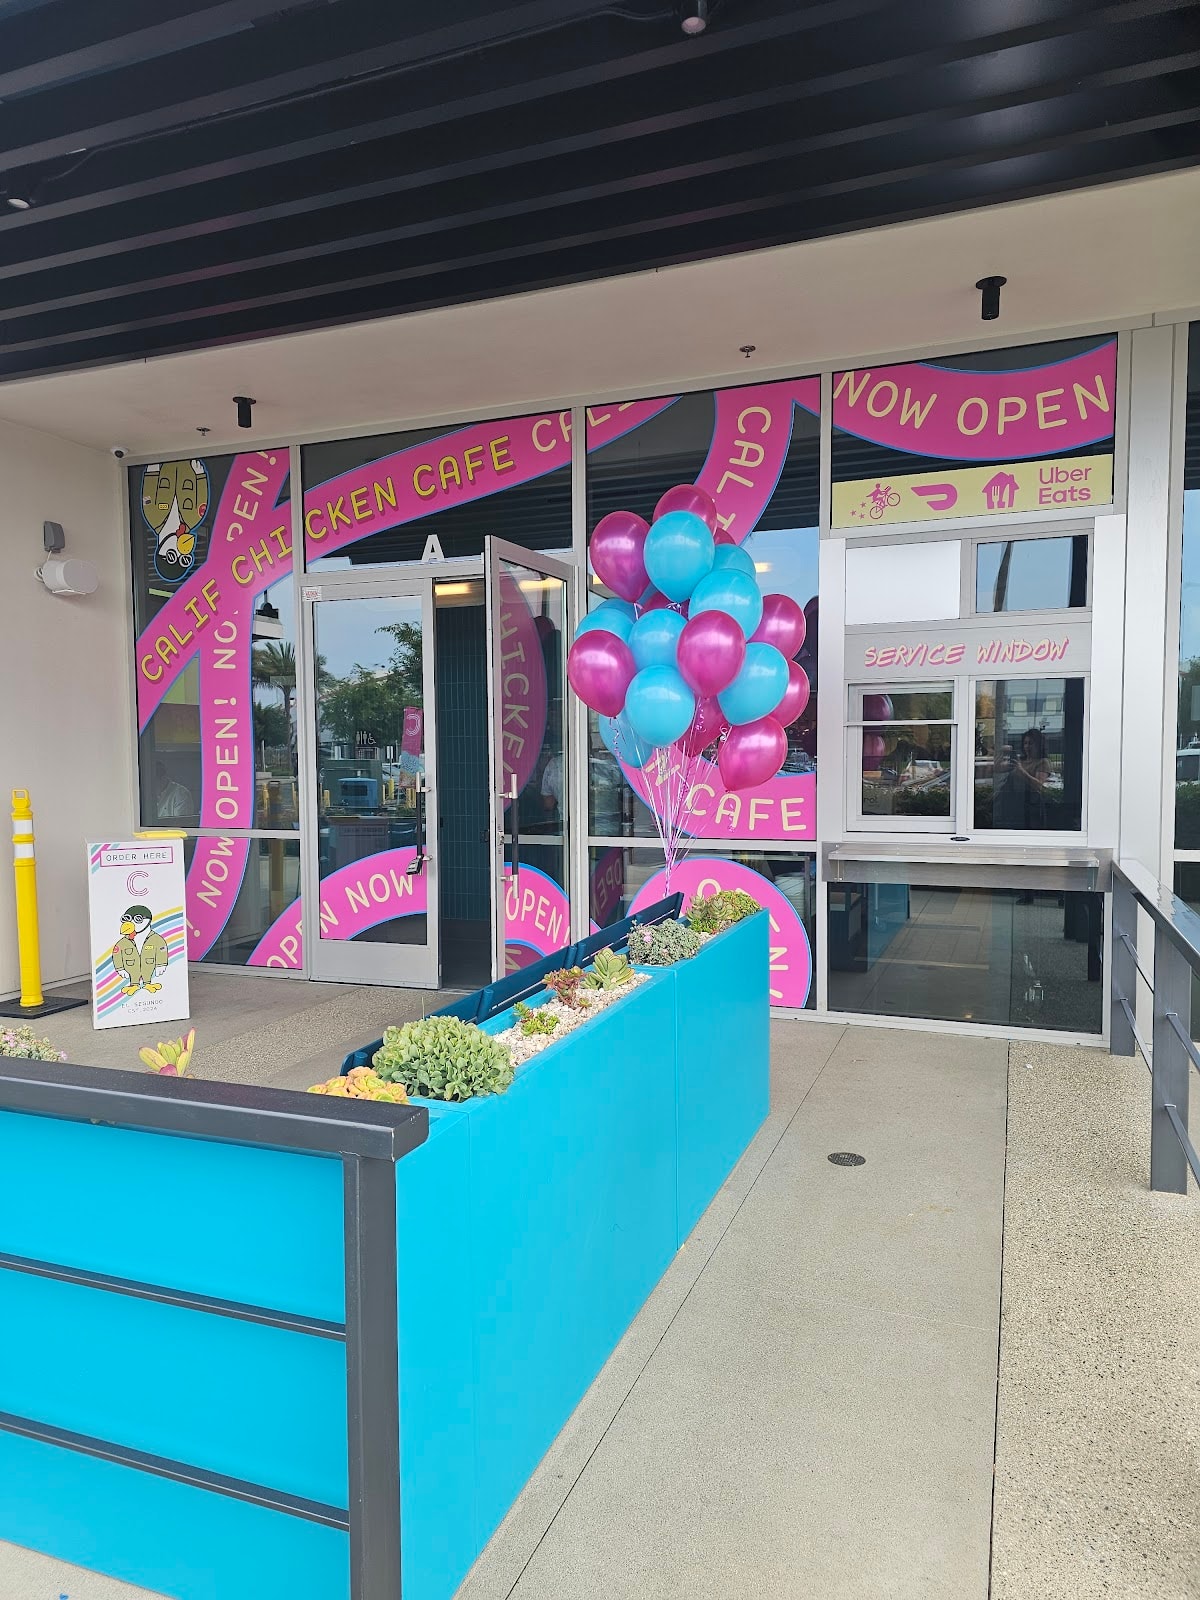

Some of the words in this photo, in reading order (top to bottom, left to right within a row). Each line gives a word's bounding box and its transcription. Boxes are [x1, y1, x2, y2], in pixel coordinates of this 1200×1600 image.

[833, 371, 937, 429] NOW
[957, 375, 1110, 435] OPEN
[1039, 466, 1092, 484] Uber
[1039, 486, 1091, 504] Eats
[141, 579, 218, 682] CALIF
[231, 477, 397, 584] CHICKEN
[412, 436, 515, 497] CAFE
[531, 402, 636, 452] CAL
[421, 534, 446, 562] A
[213, 610, 239, 669] NO
[864, 643, 965, 667] SERVICE
[977, 636, 1069, 664] WINDOW
[213, 696, 239, 820] OPEN!
[685, 784, 806, 831] CAFE
[106, 853, 137, 862] ORDER
[143, 851, 168, 860] HERE
[197, 837, 234, 908] NOW
[127, 870, 149, 897] C
[345, 869, 412, 914] NOW
